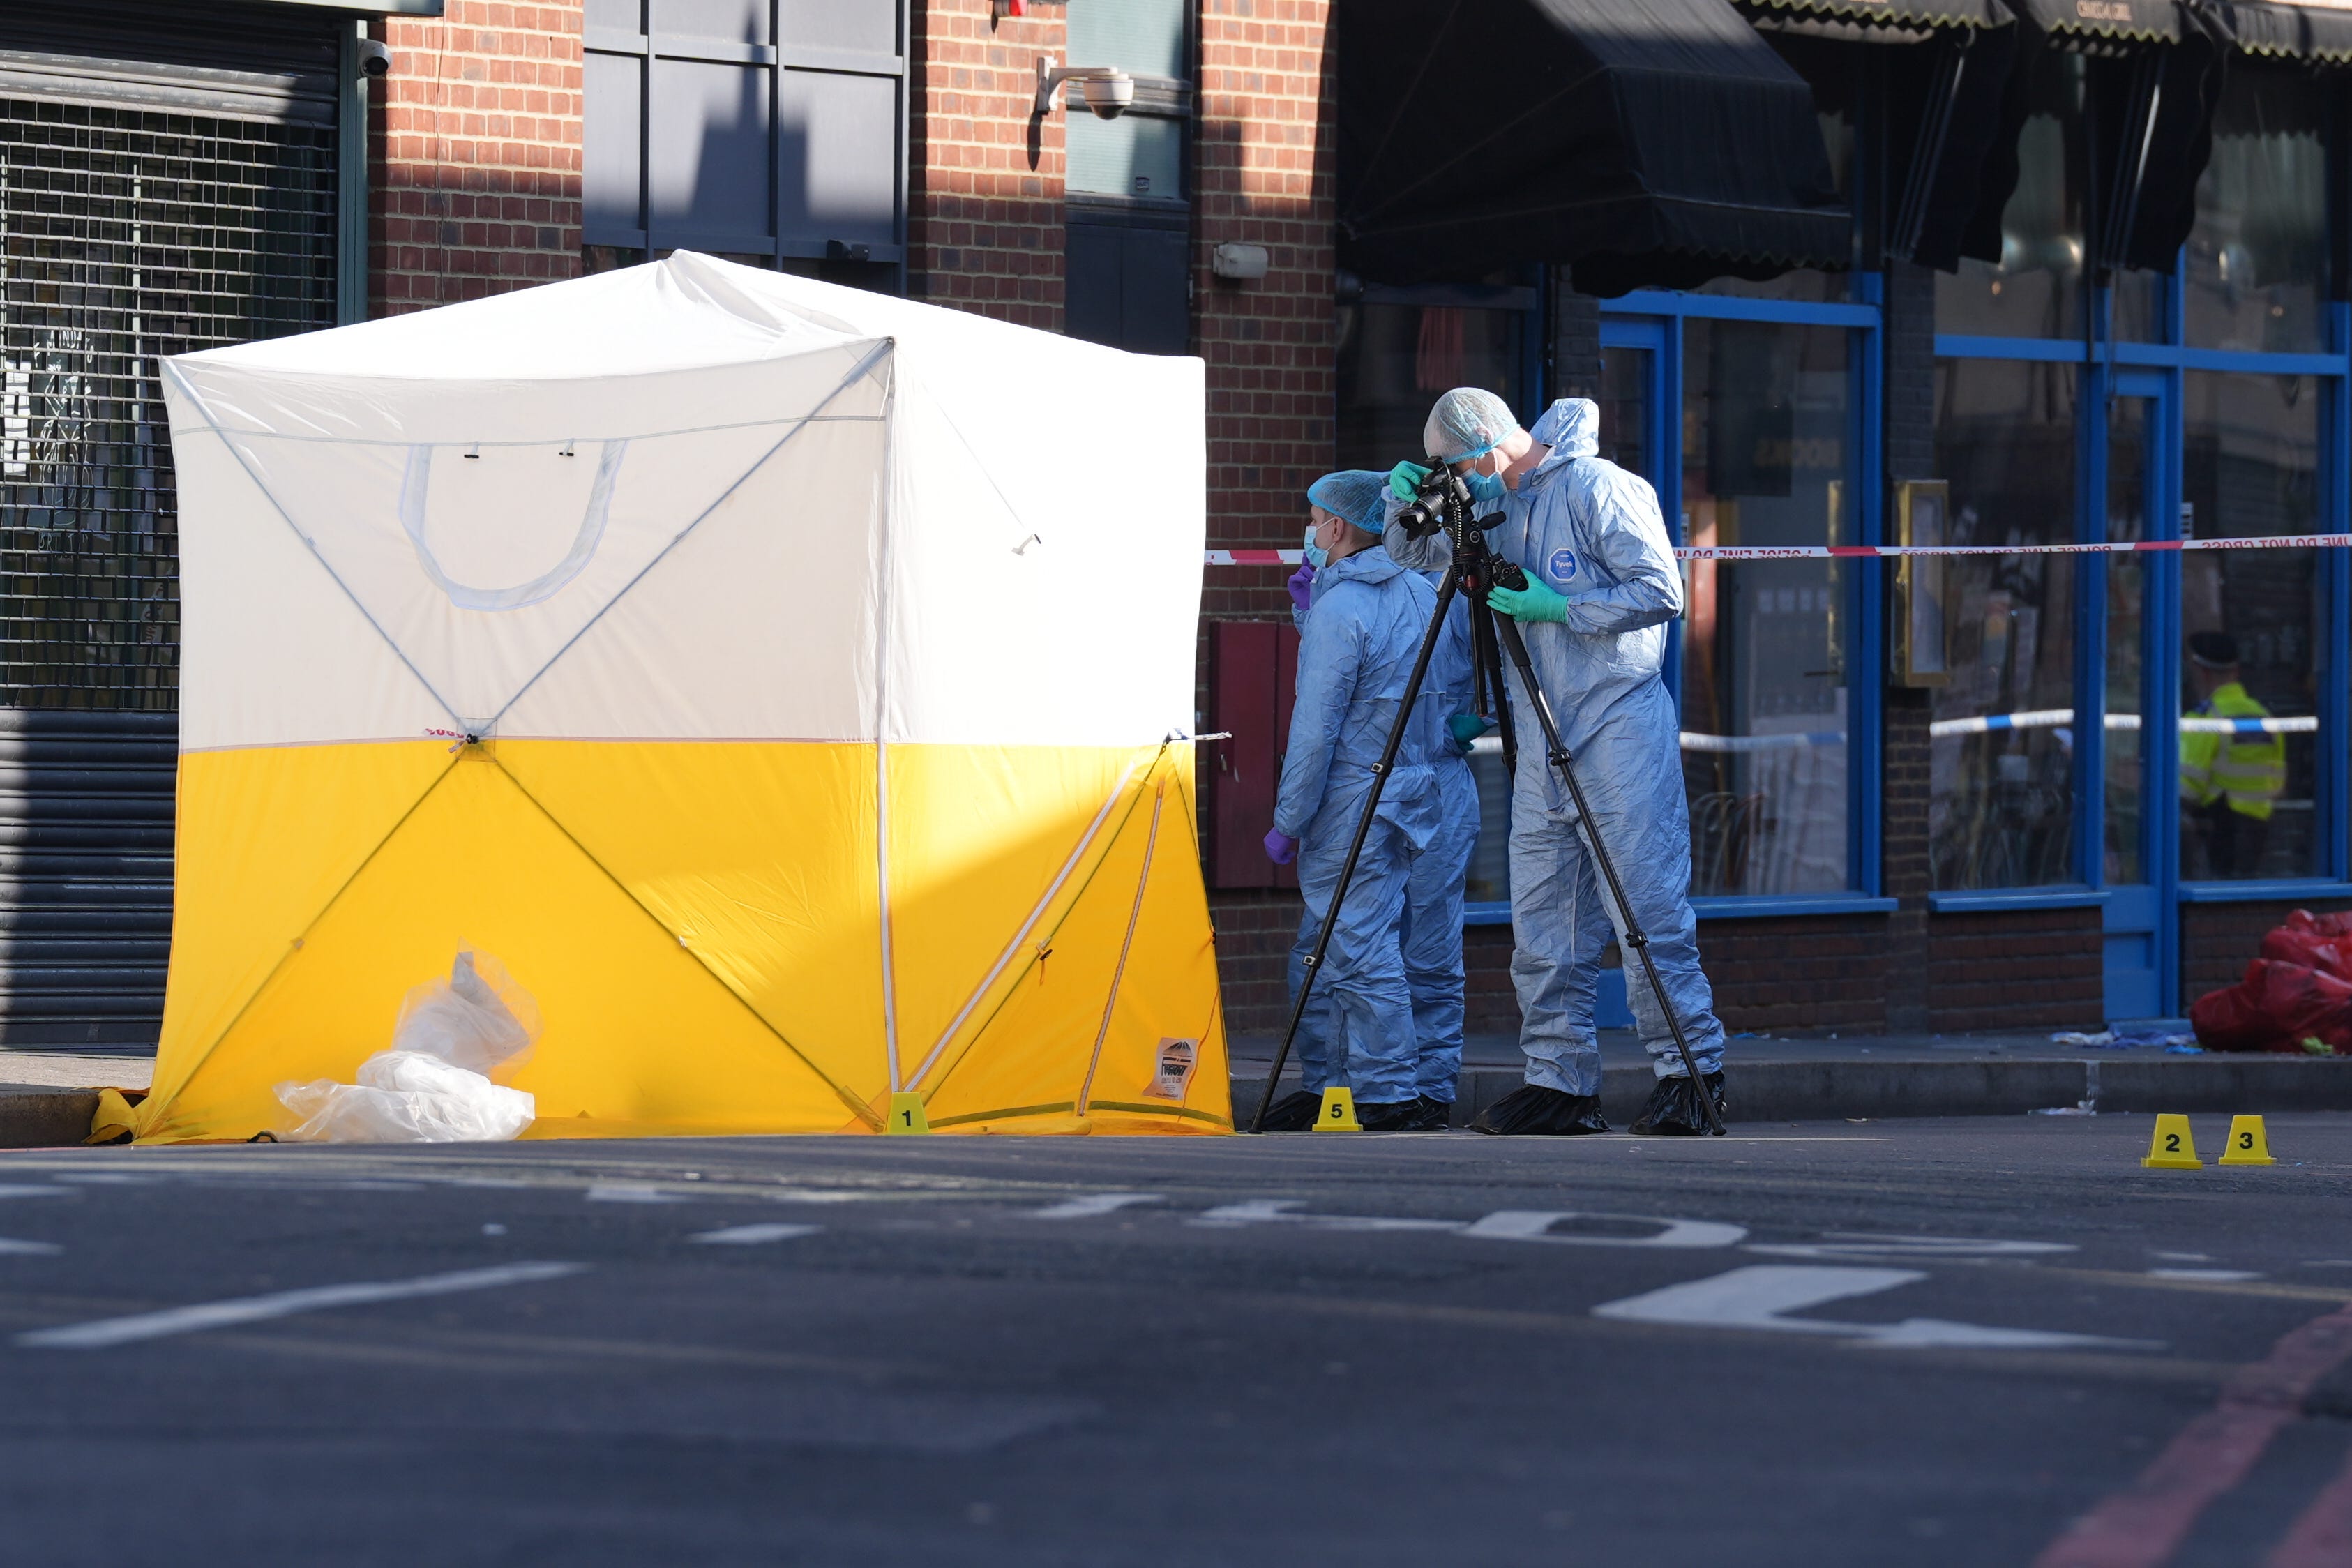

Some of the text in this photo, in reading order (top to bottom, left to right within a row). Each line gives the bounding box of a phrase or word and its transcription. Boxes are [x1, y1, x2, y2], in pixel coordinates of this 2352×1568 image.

[1555, 560, 1574, 568] Tyvek
[901, 1110, 911, 1126] 1
[1330, 1103, 1343, 1119] 5
[2165, 1133, 2180, 1152] 2
[2239, 1131, 2254, 1149] 3
